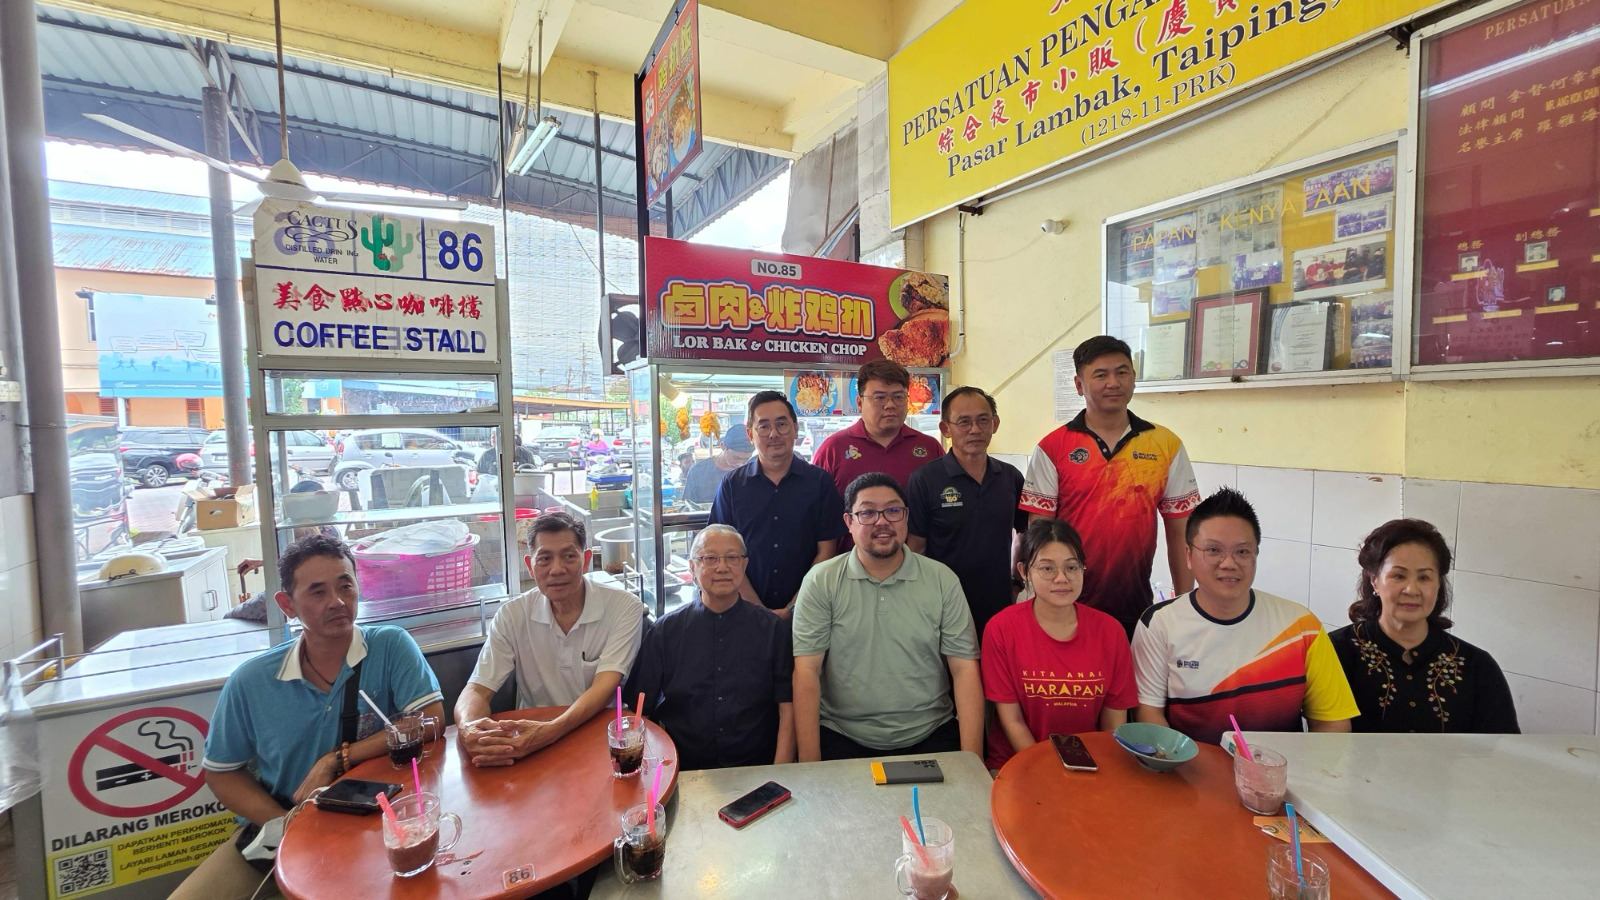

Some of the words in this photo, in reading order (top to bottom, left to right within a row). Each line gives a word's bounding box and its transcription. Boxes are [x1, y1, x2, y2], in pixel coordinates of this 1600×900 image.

[903, 47, 1032, 147] PERSATUAN
[1040, 0, 1160, 68] PENGA
[1081, 62, 1237, 145] (1218-11-PRK)
[947, 137, 1008, 178] Pasar
[1016, 74, 1142, 148] Lambak,
[287, 211, 358, 240] CACTUS
[1133, 222, 1195, 252] PAPAN
[1220, 175, 1371, 231] KENYATAAN
[285, 244, 323, 254] DISTILLED
[314, 257, 338, 265] WATER
[438, 230, 484, 272] 86
[757, 262, 797, 277] NO.85
[272, 282, 484, 320] 美食點心咖啡檔
[274, 321, 390, 350] COFFEE
[406, 327, 486, 353] STALL
[673, 336, 709, 349] LOR
[712, 337, 748, 350] BAK
[750, 340, 762, 351] &
[765, 340, 828, 355] CHICKEN
[831, 343, 867, 356] CHOP
[1023, 670, 1055, 678] KITA
[1023, 681, 1104, 696] HARAPAN
[51, 818, 149, 852] DILARANG
[155, 801, 227, 827] MEROKO
[117, 832, 168, 851] DAPATKAN
[132, 839, 179, 856] BERHENTI
[181, 827, 227, 843] MEROKOK
[120, 856, 153, 871] LAYARI
[155, 848, 188, 862] LAMAN
[138, 849, 217, 876] jomquit.moh.gov.
[509, 869, 530, 883] 86
